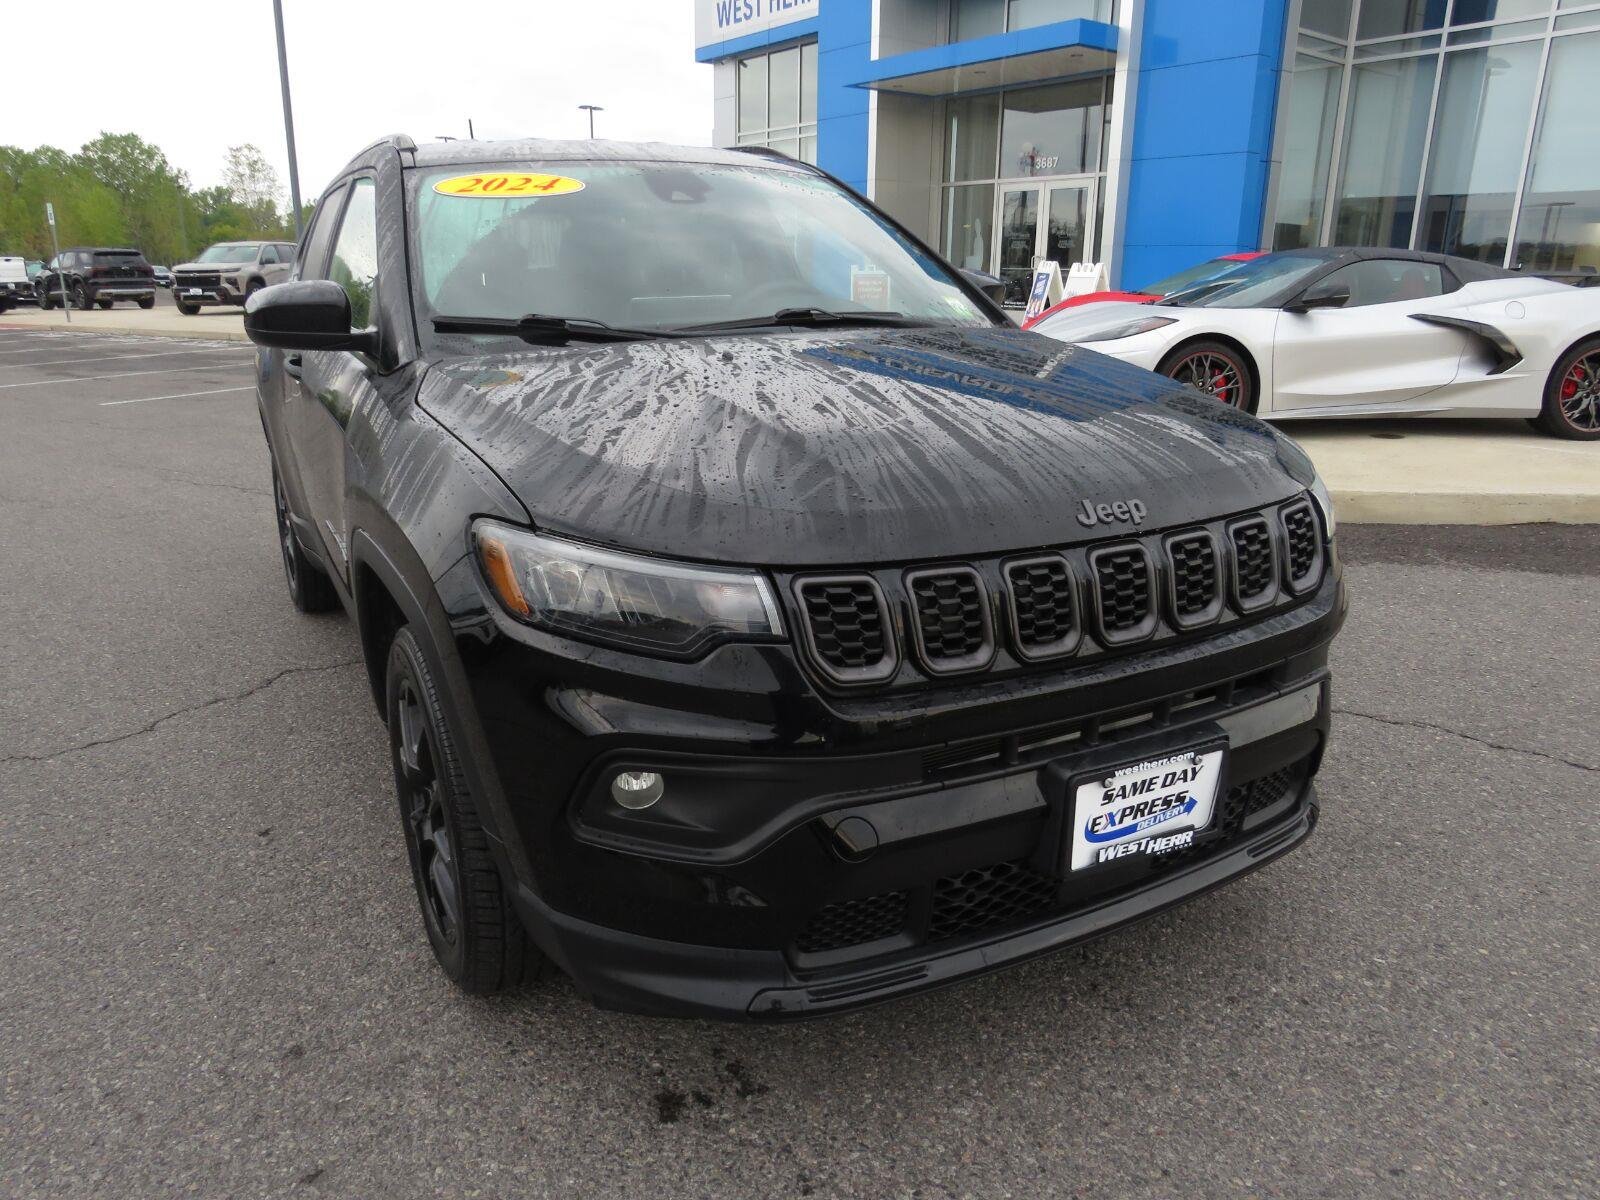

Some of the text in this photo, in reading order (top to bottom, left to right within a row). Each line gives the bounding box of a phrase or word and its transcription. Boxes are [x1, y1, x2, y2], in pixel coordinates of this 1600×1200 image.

[1036, 156, 1059, 170] 3687
[454, 177, 561, 193] 2024
[1076, 499, 1147, 527] Jeep
[1114, 751, 1195, 777] westherr.com
[1101, 765, 1204, 806] SAME DAY
[1090, 790, 1189, 833] EXPRESS
[1136, 804, 1187, 831] DELIVERY
